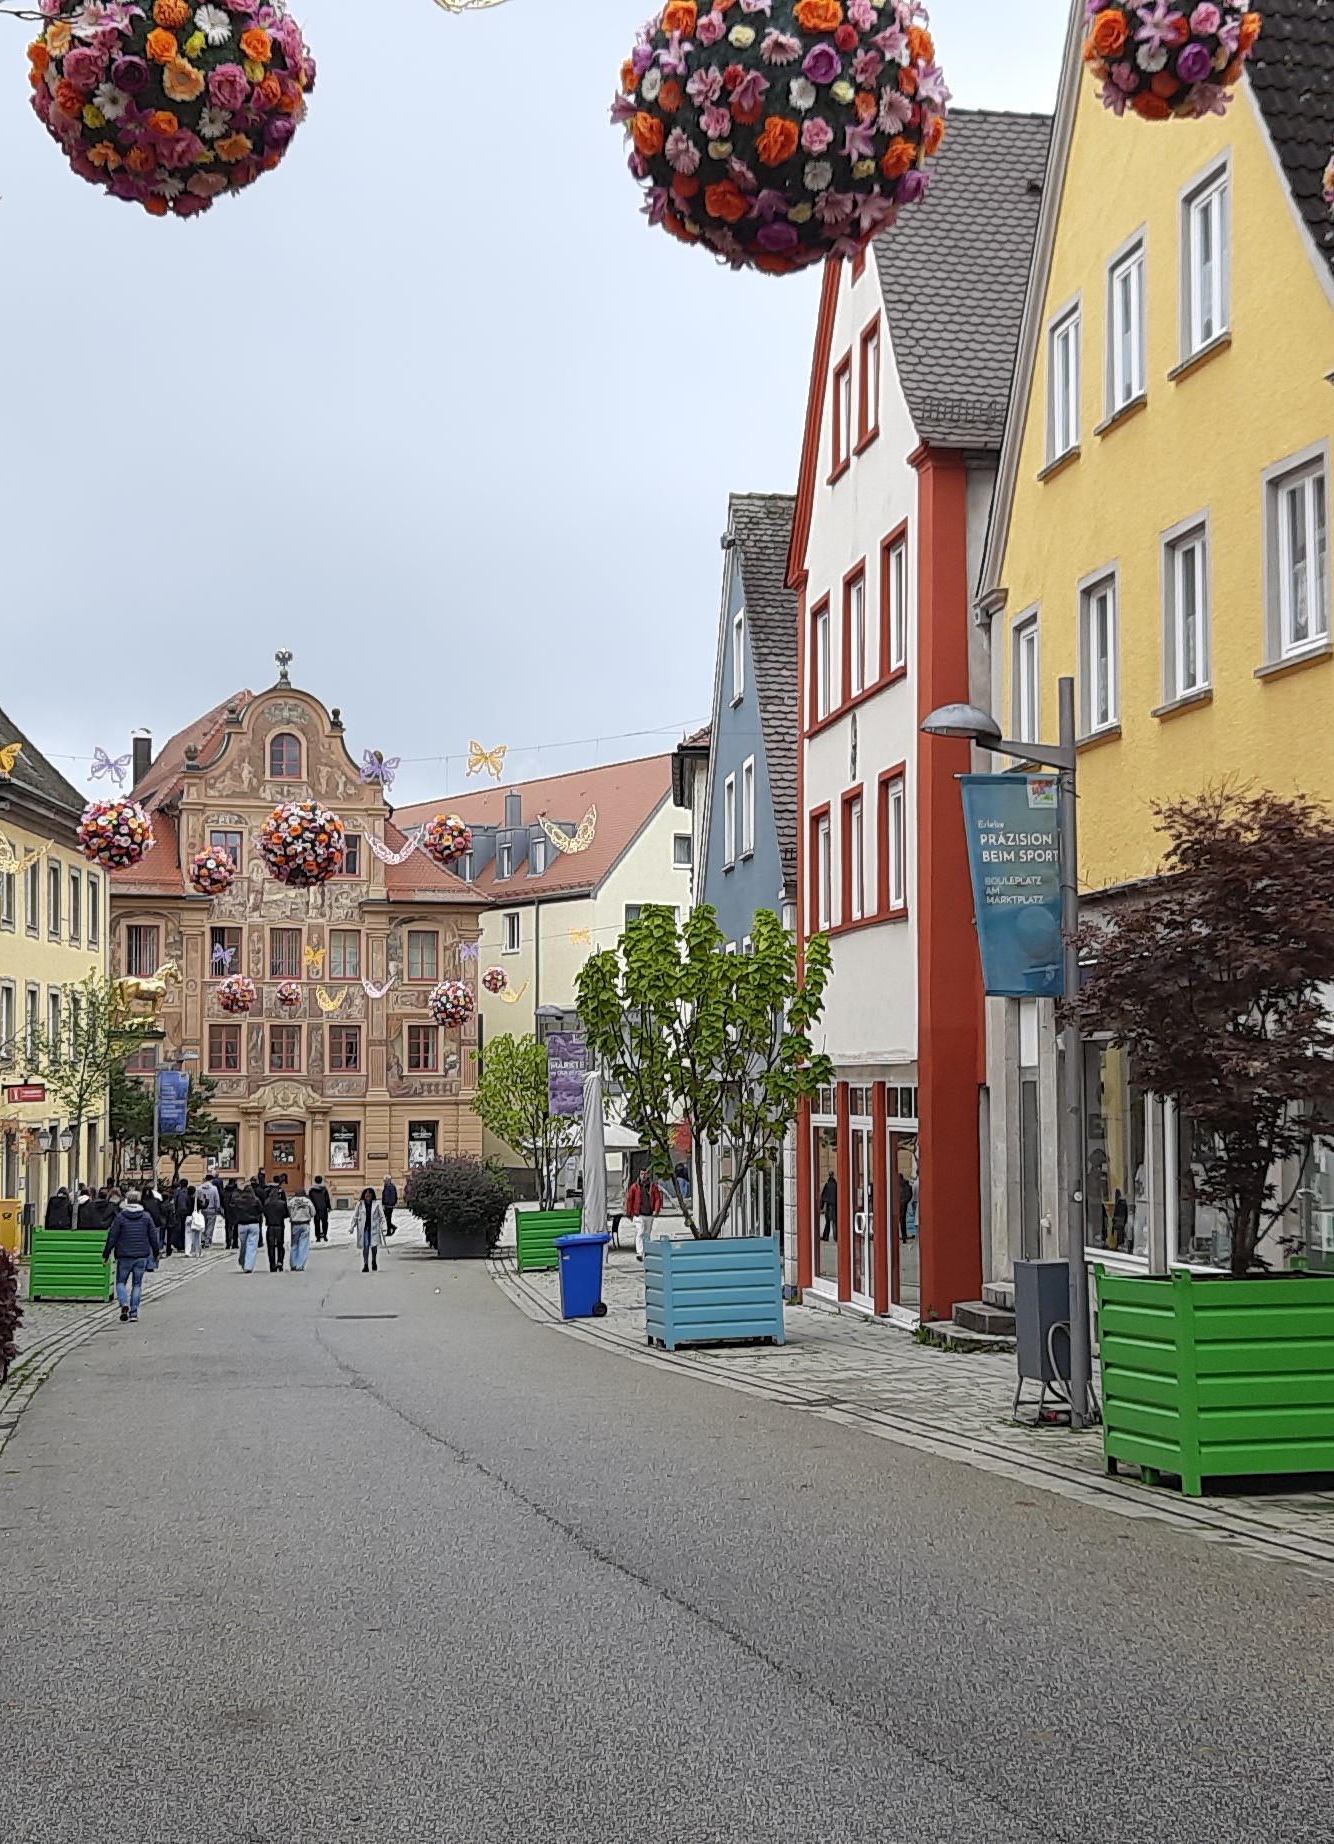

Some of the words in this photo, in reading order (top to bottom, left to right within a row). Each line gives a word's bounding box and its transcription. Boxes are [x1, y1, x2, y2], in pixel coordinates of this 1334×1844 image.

[980, 831, 1052, 846] PRÄZISION
[982, 850, 1015, 863] BEIM
[1019, 849, 1058, 862] SPORT
[985, 886, 1000, 895] AM
[986, 895, 1044, 905] MARKTPLATZ
